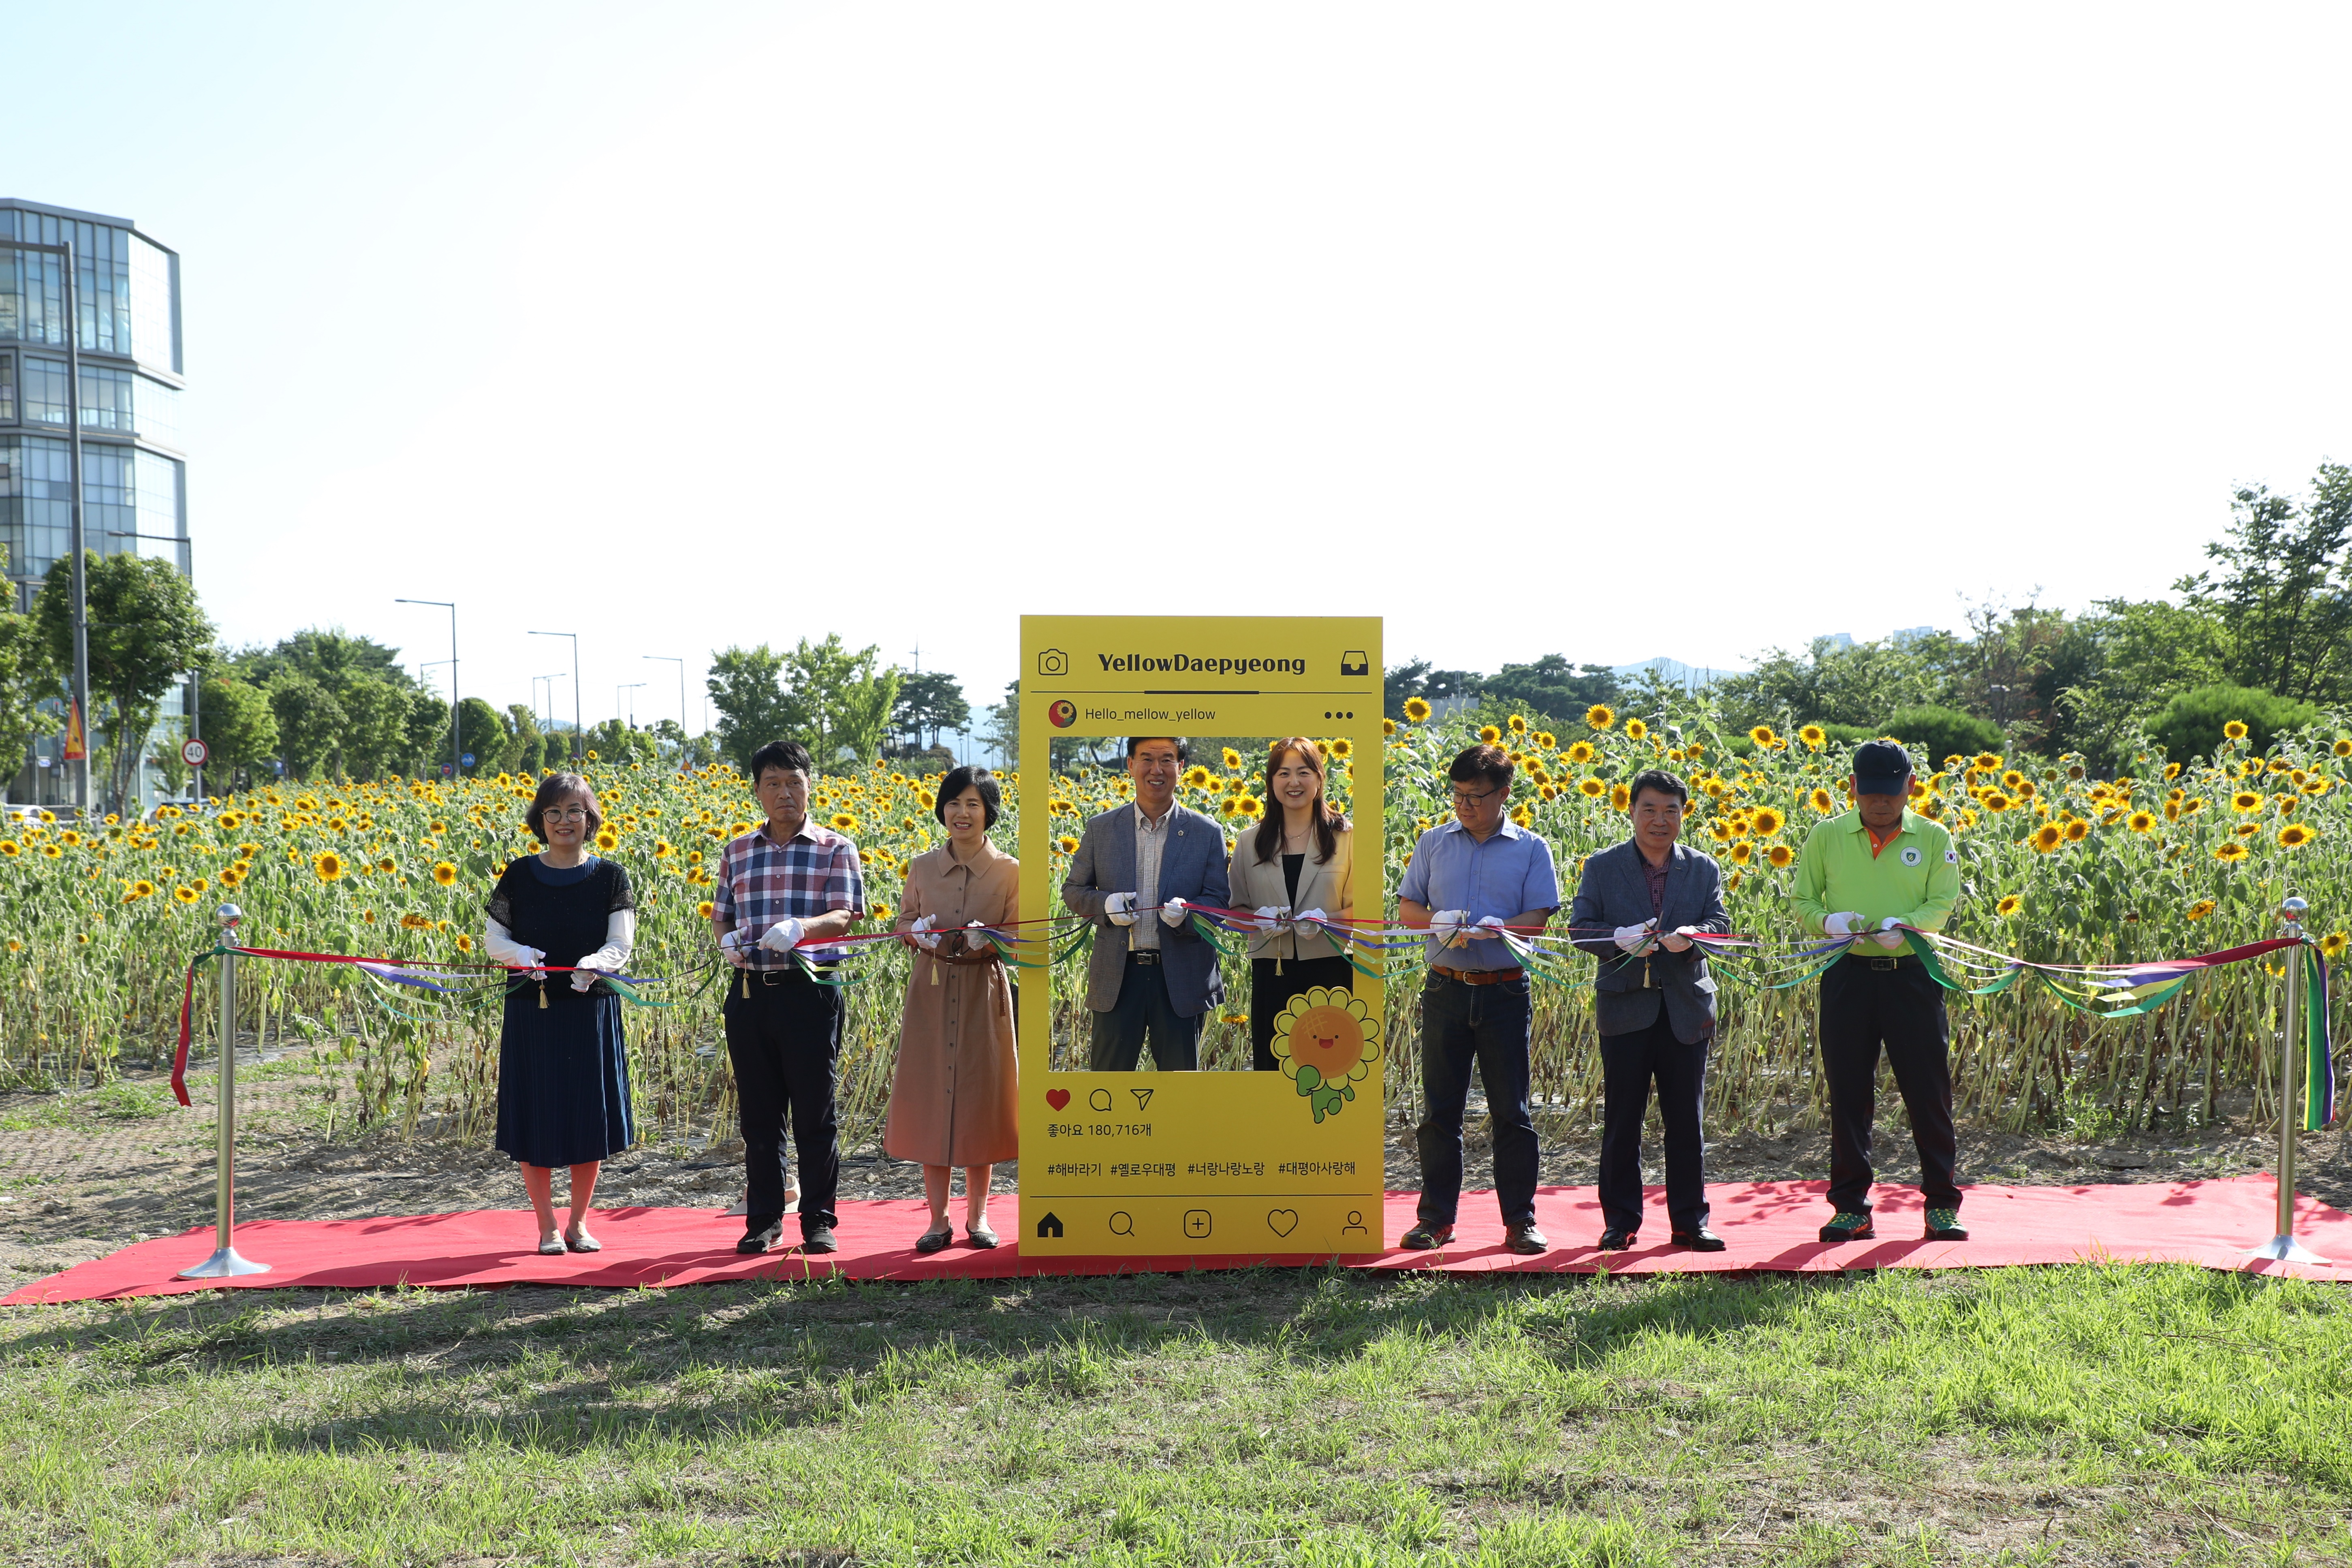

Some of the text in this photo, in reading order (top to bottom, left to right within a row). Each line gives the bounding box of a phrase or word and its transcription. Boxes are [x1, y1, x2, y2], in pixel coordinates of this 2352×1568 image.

[1097, 653, 1305, 675] YellowDaepyeong
[1085, 708, 1216, 722] Hello_mellow_yellow
[187, 746, 202, 758] 40
[1047, 1123, 1151, 1137] 좋아요 180,716개
[1047, 1161, 1355, 1177] #해바라기 #옐로우대평 #너랑나랑노랑 #대평아사랑해
